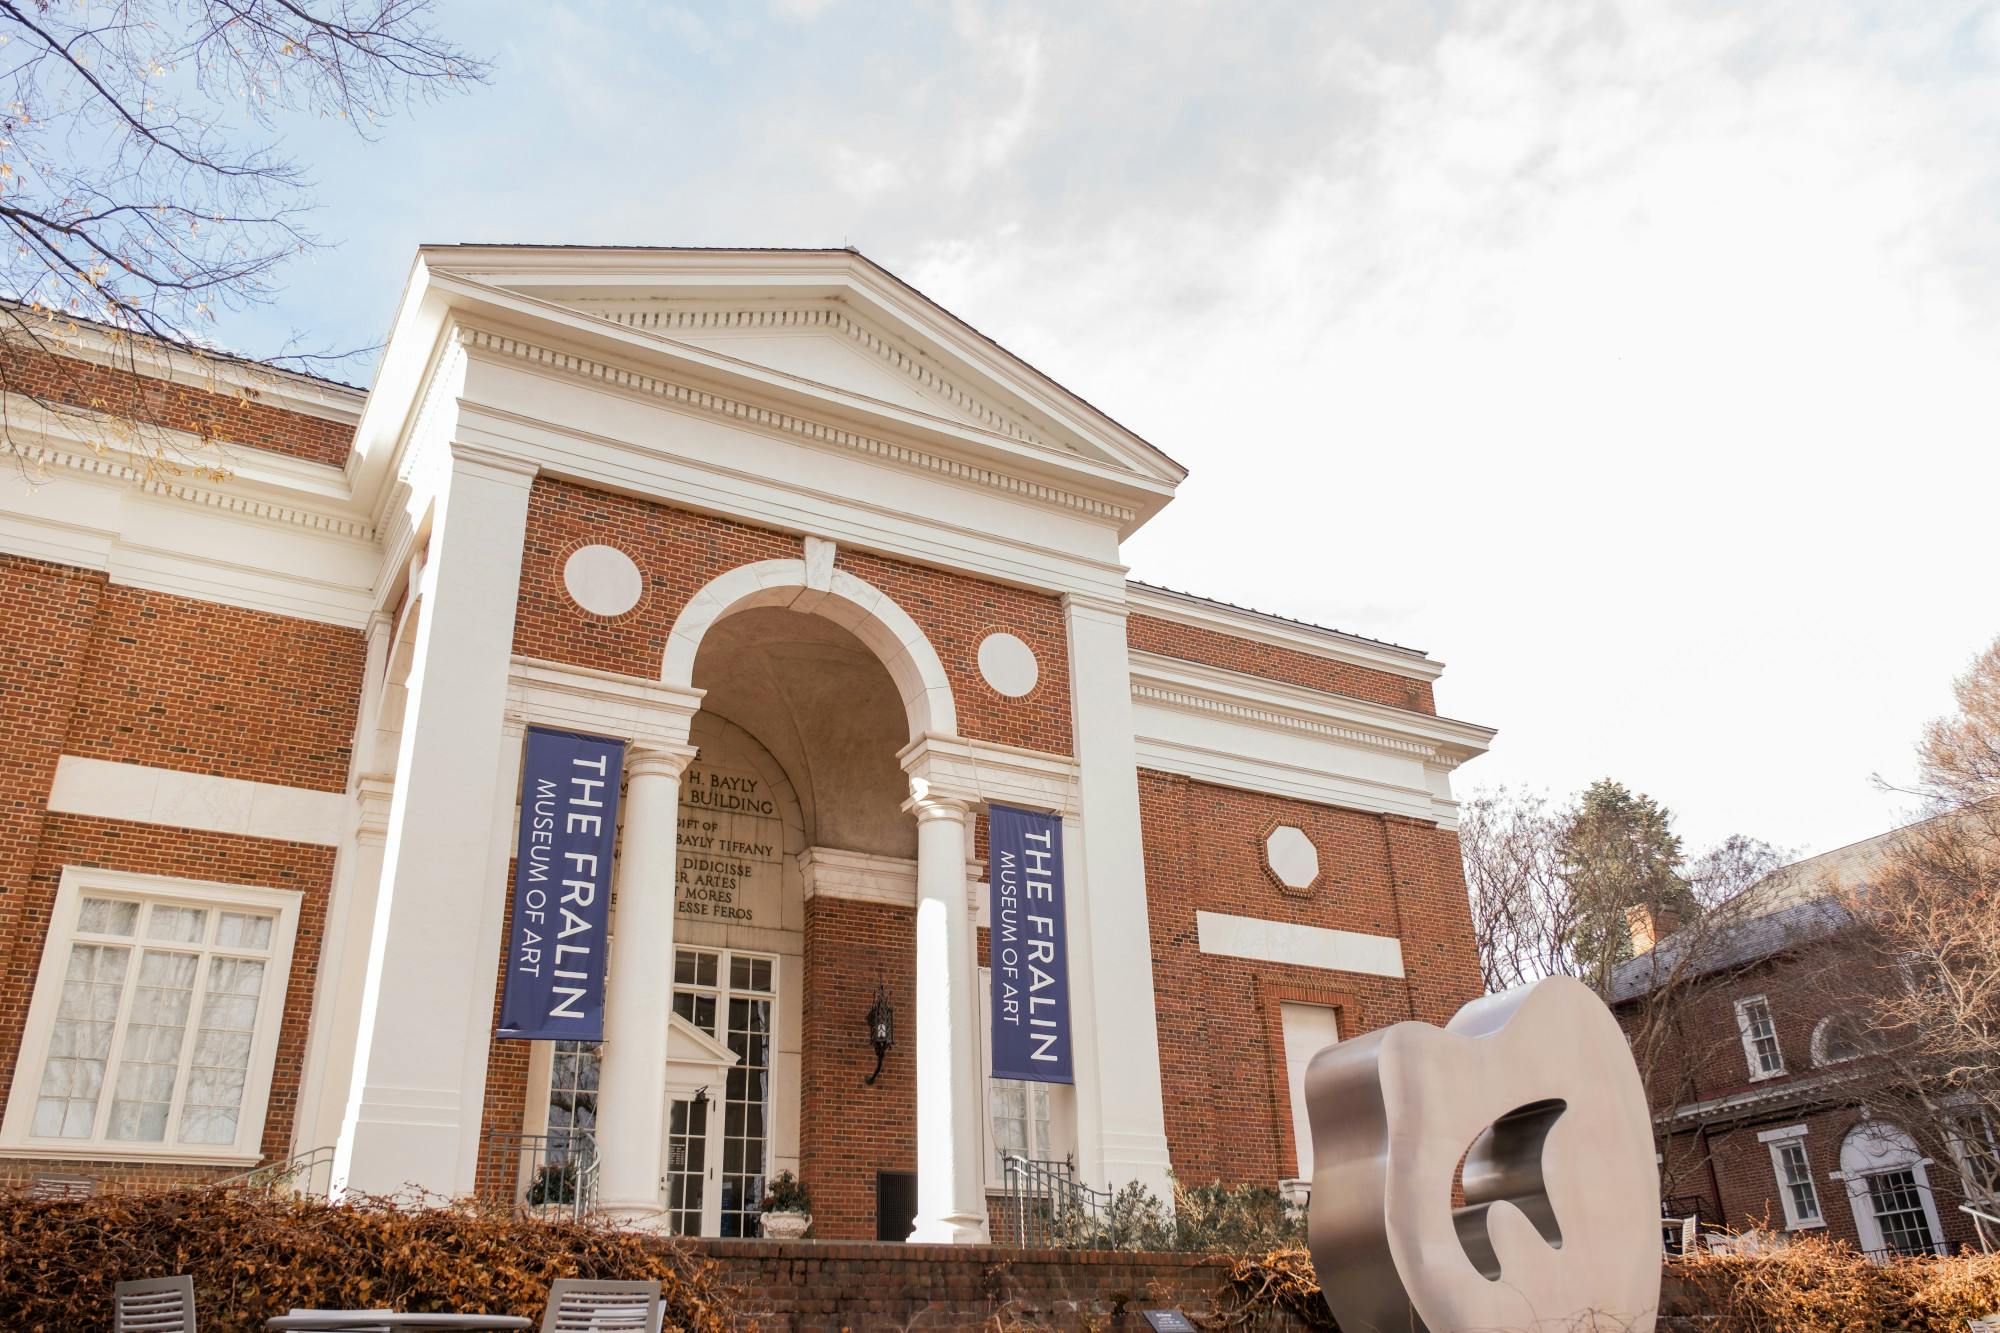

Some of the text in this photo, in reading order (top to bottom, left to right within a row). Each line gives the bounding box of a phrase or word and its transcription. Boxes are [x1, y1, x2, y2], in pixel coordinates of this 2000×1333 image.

[711, 774, 758, 793] BAYLY
[690, 790, 774, 815] BUILDING
[702, 822, 718, 832] OF
[719, 839, 774, 857] TIFFANY
[519, 778, 558, 978] MUSEUM OF ART
[683, 858, 753, 878] DIDICISSE
[549, 755, 607, 1019] THE FRALIN
[694, 874, 737, 890] ARTES
[685, 887, 733, 904] MORES
[678, 901, 753, 921] ESSE FEROS
[1000, 850, 1019, 1026] MUSEUM OF ART
[1025, 829, 1058, 1062] THE FRALIN
